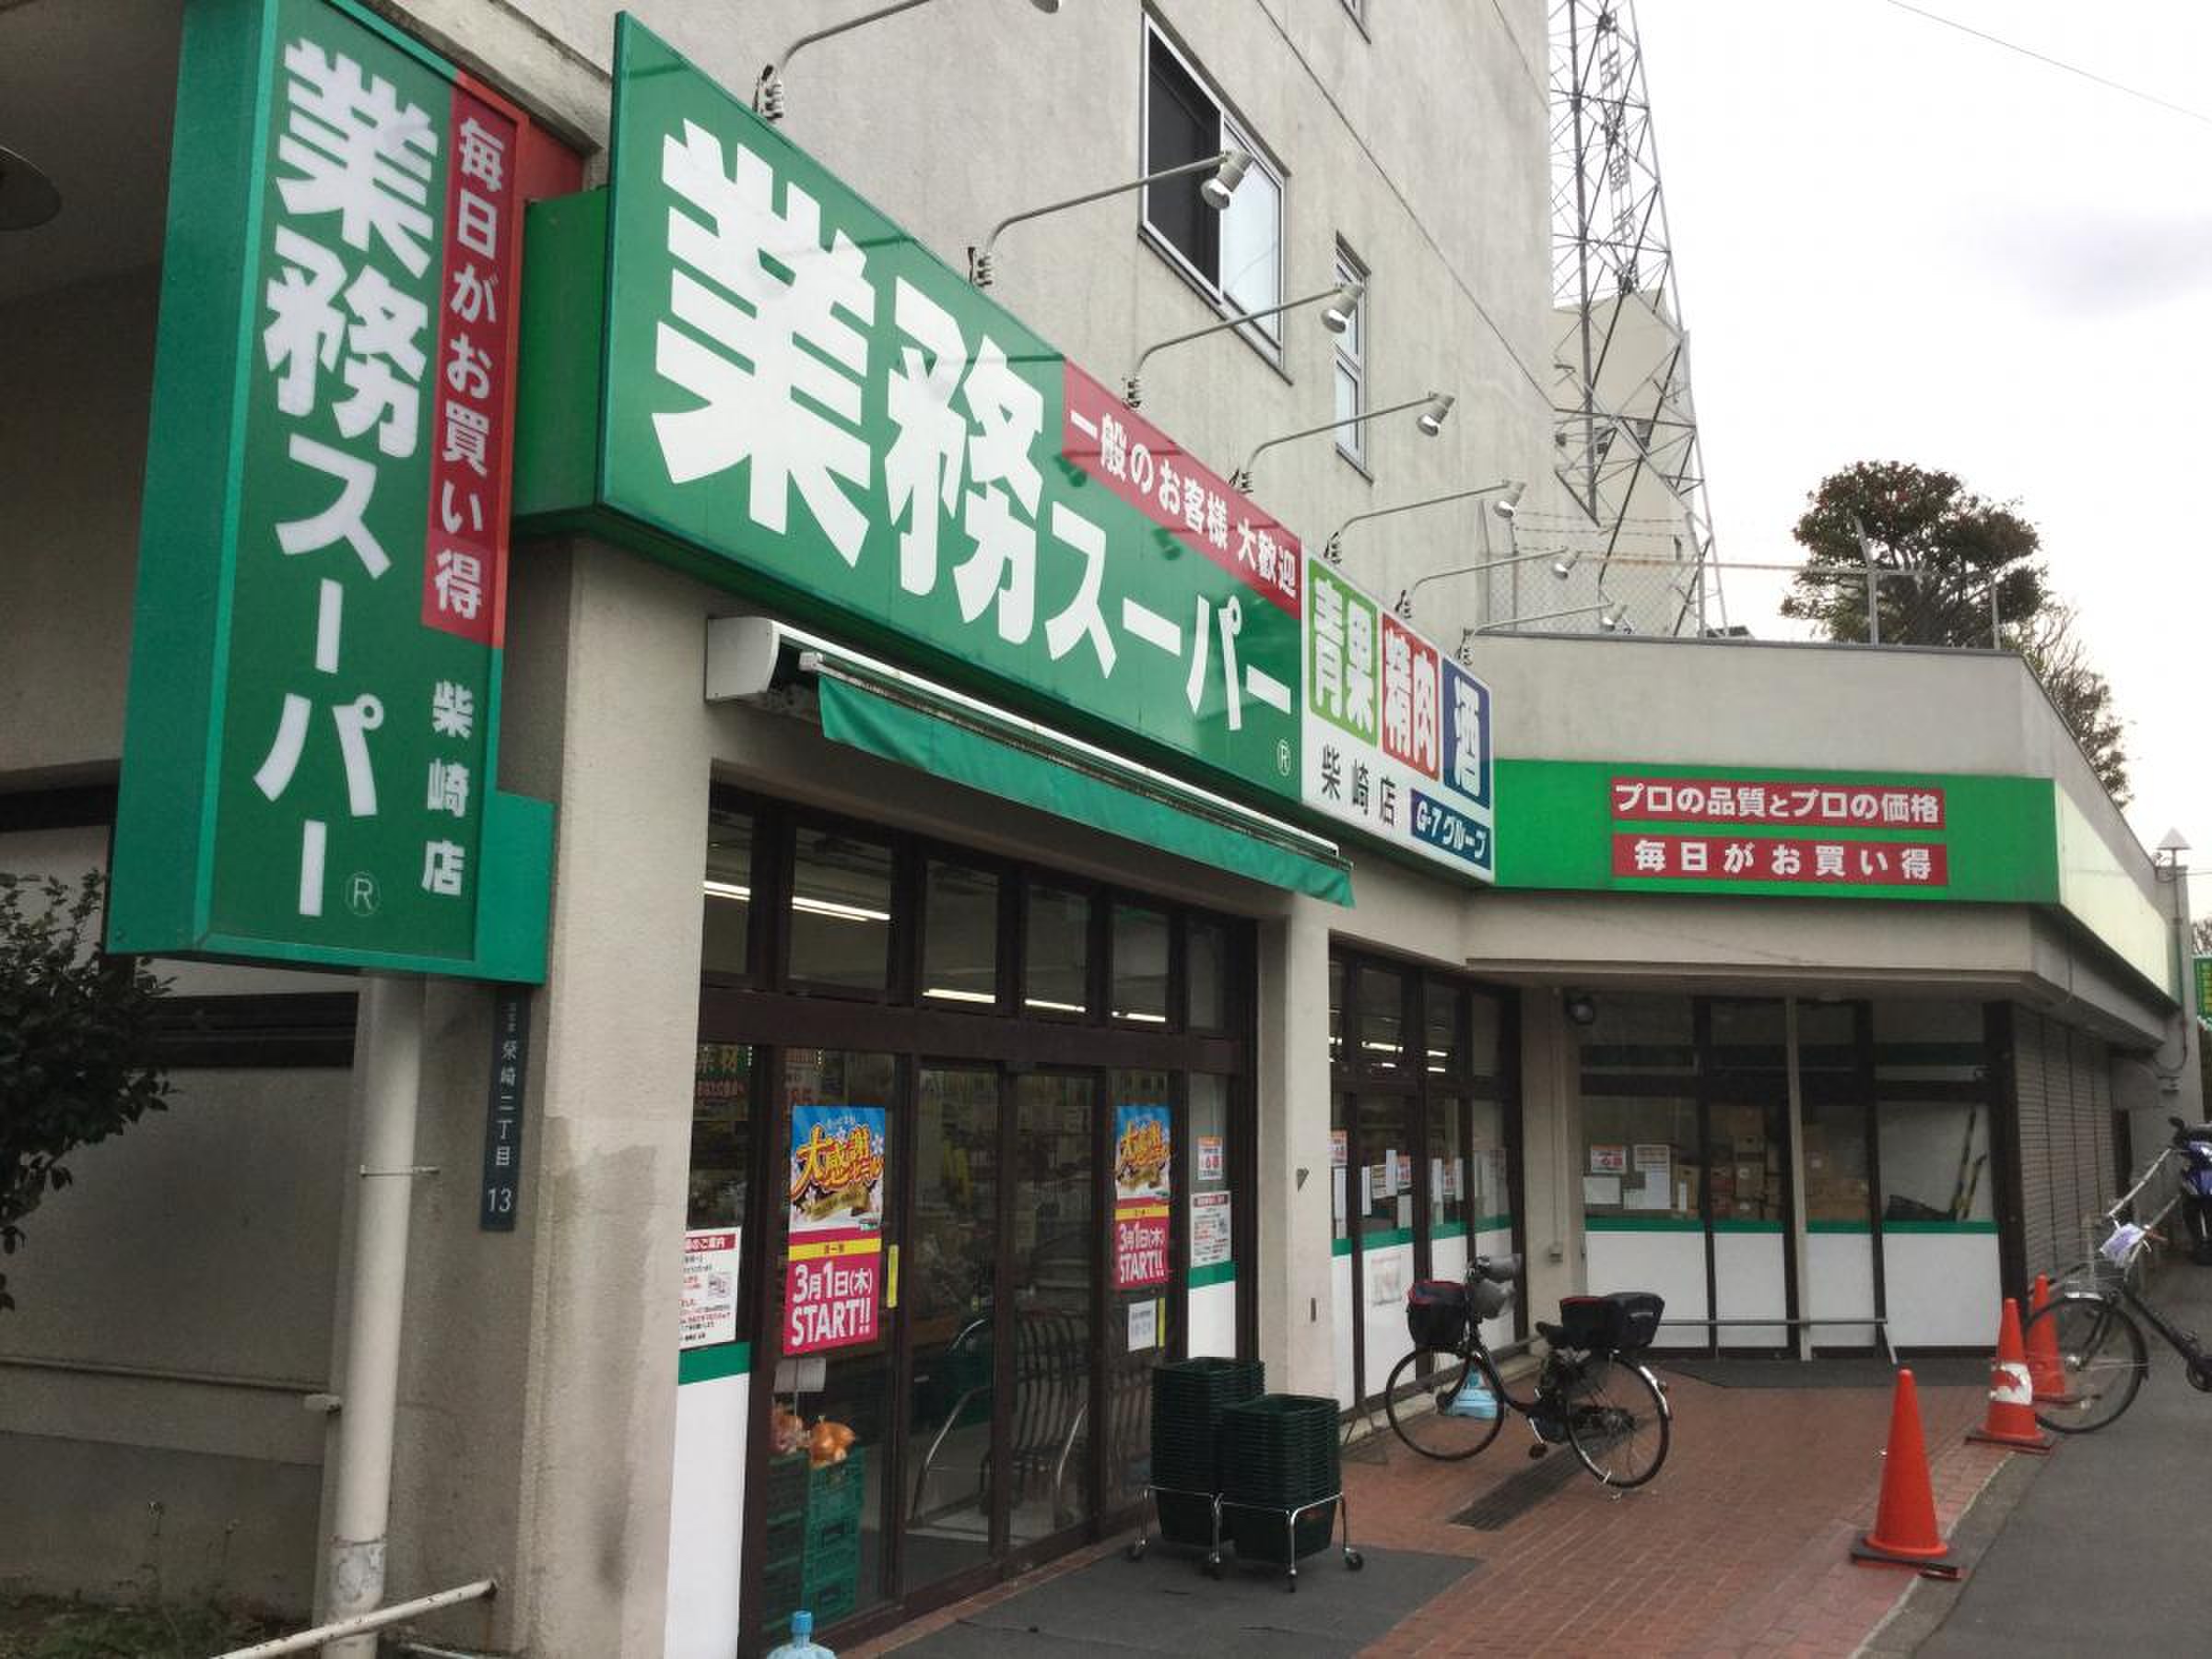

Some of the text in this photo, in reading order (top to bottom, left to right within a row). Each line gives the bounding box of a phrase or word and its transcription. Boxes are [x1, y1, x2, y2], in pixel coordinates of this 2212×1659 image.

[434, 119, 505, 621] 毎日がお買い得
[652, 118, 1291, 731] 業務スーパー
[253, 38, 439, 918] 業務スーパー
[1070, 411, 1297, 599] 一般のお客様 大歓迎
[1313, 577, 1374, 735] 青果
[1385, 627, 1437, 771] 精肉
[420, 681, 475, 898] 柴崎店
[1321, 743, 1397, 828] 柴崎店
[1453, 675, 1480, 798] 酒
[1616, 782, 1939, 824] プロの品質とプロの価格
[1634, 840, 1932, 880] 毎日がお買い得
[488, 1187, 512, 1213] 13
[791, 1297, 871, 1347] START!!
[793, 1261, 873, 1303] 3月1日(木)
